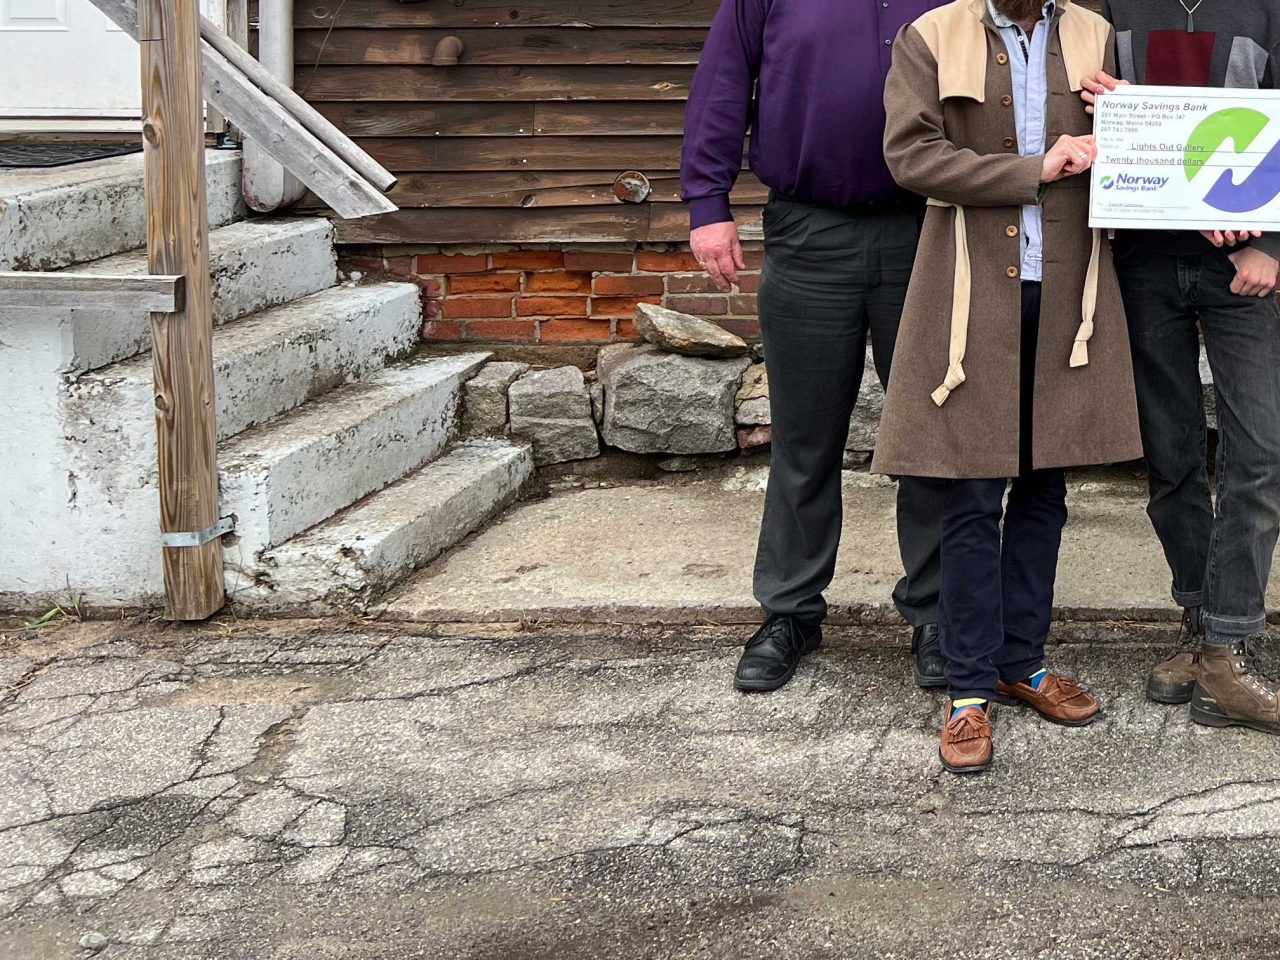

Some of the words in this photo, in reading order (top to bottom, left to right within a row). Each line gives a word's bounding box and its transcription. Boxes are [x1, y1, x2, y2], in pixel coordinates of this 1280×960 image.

[1102, 100, 1139, 111] Norway
[1141, 102, 1181, 112] Savings
[1183, 103, 1208, 112] Bank
[1131, 143, 1157, 152] Lights
[1159, 143, 1175, 151] Out
[1176, 144, 1205, 153] Gallery
[1105, 155, 1134, 165] Twenty
[1136, 156, 1175, 165] thousand
[1176, 157, 1205, 166] dollars
[1116, 173, 1170, 188] Norway
